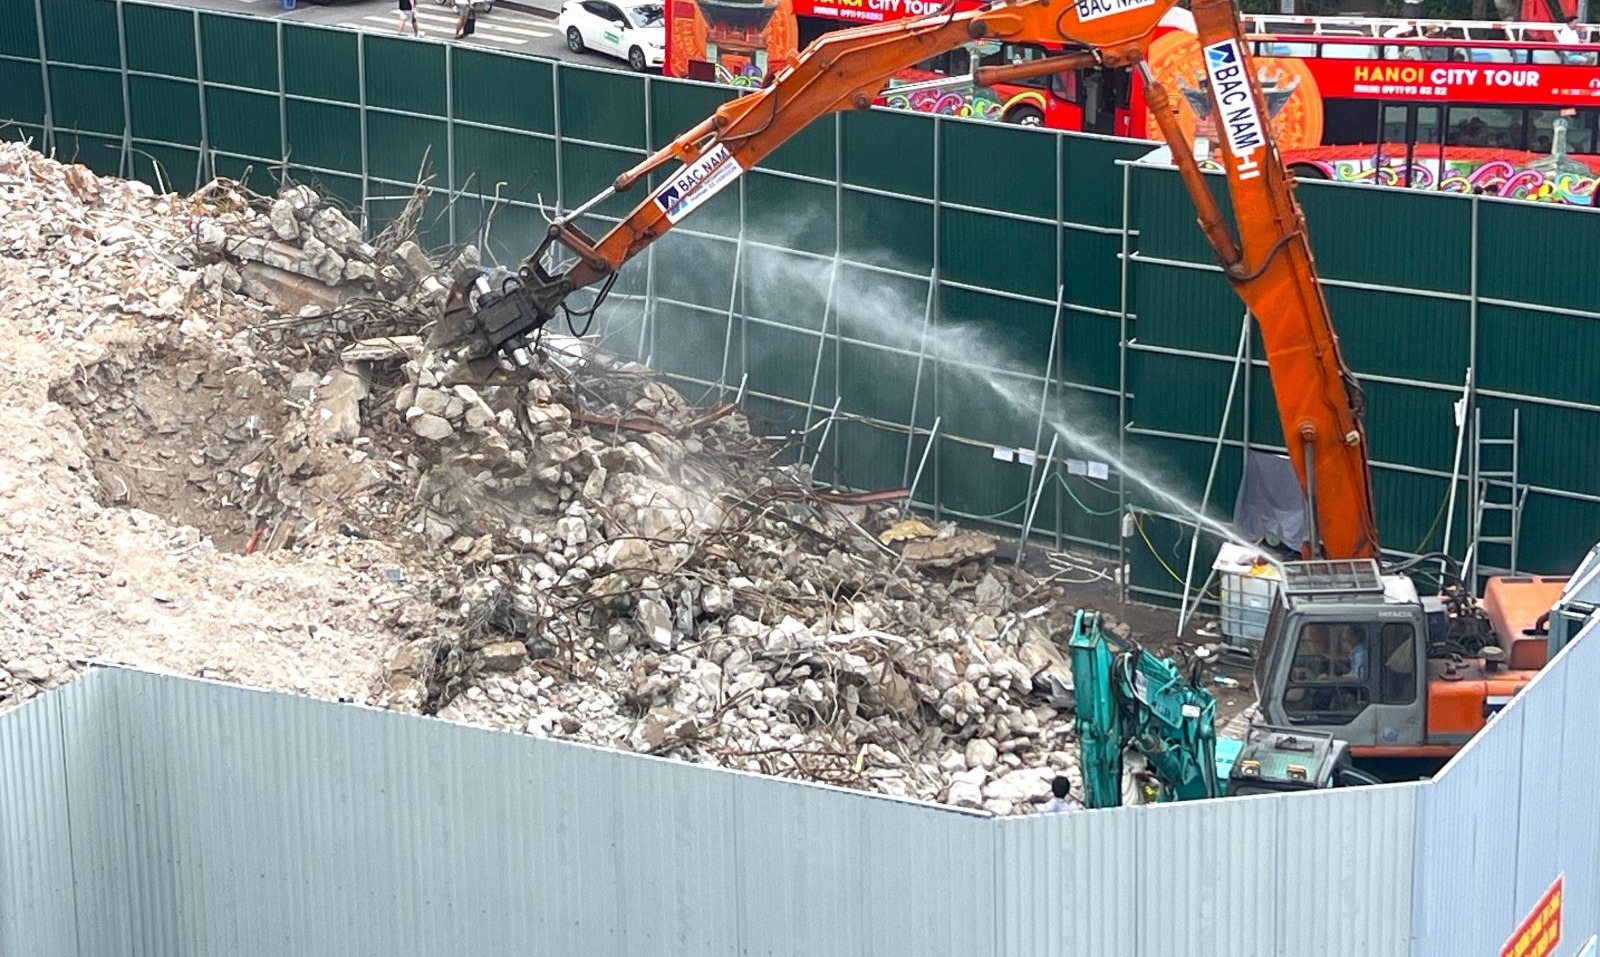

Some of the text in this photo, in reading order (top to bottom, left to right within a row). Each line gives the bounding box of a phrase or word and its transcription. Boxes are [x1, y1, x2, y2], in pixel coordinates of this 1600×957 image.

[868, 0, 899, 12] CITY
[1354, 66, 1540, 87] HANOI CITY TOUR
[1214, 65, 1260, 150] BAC NAM
[678, 169, 703, 192] BAC
[701, 148, 729, 173] NAM
